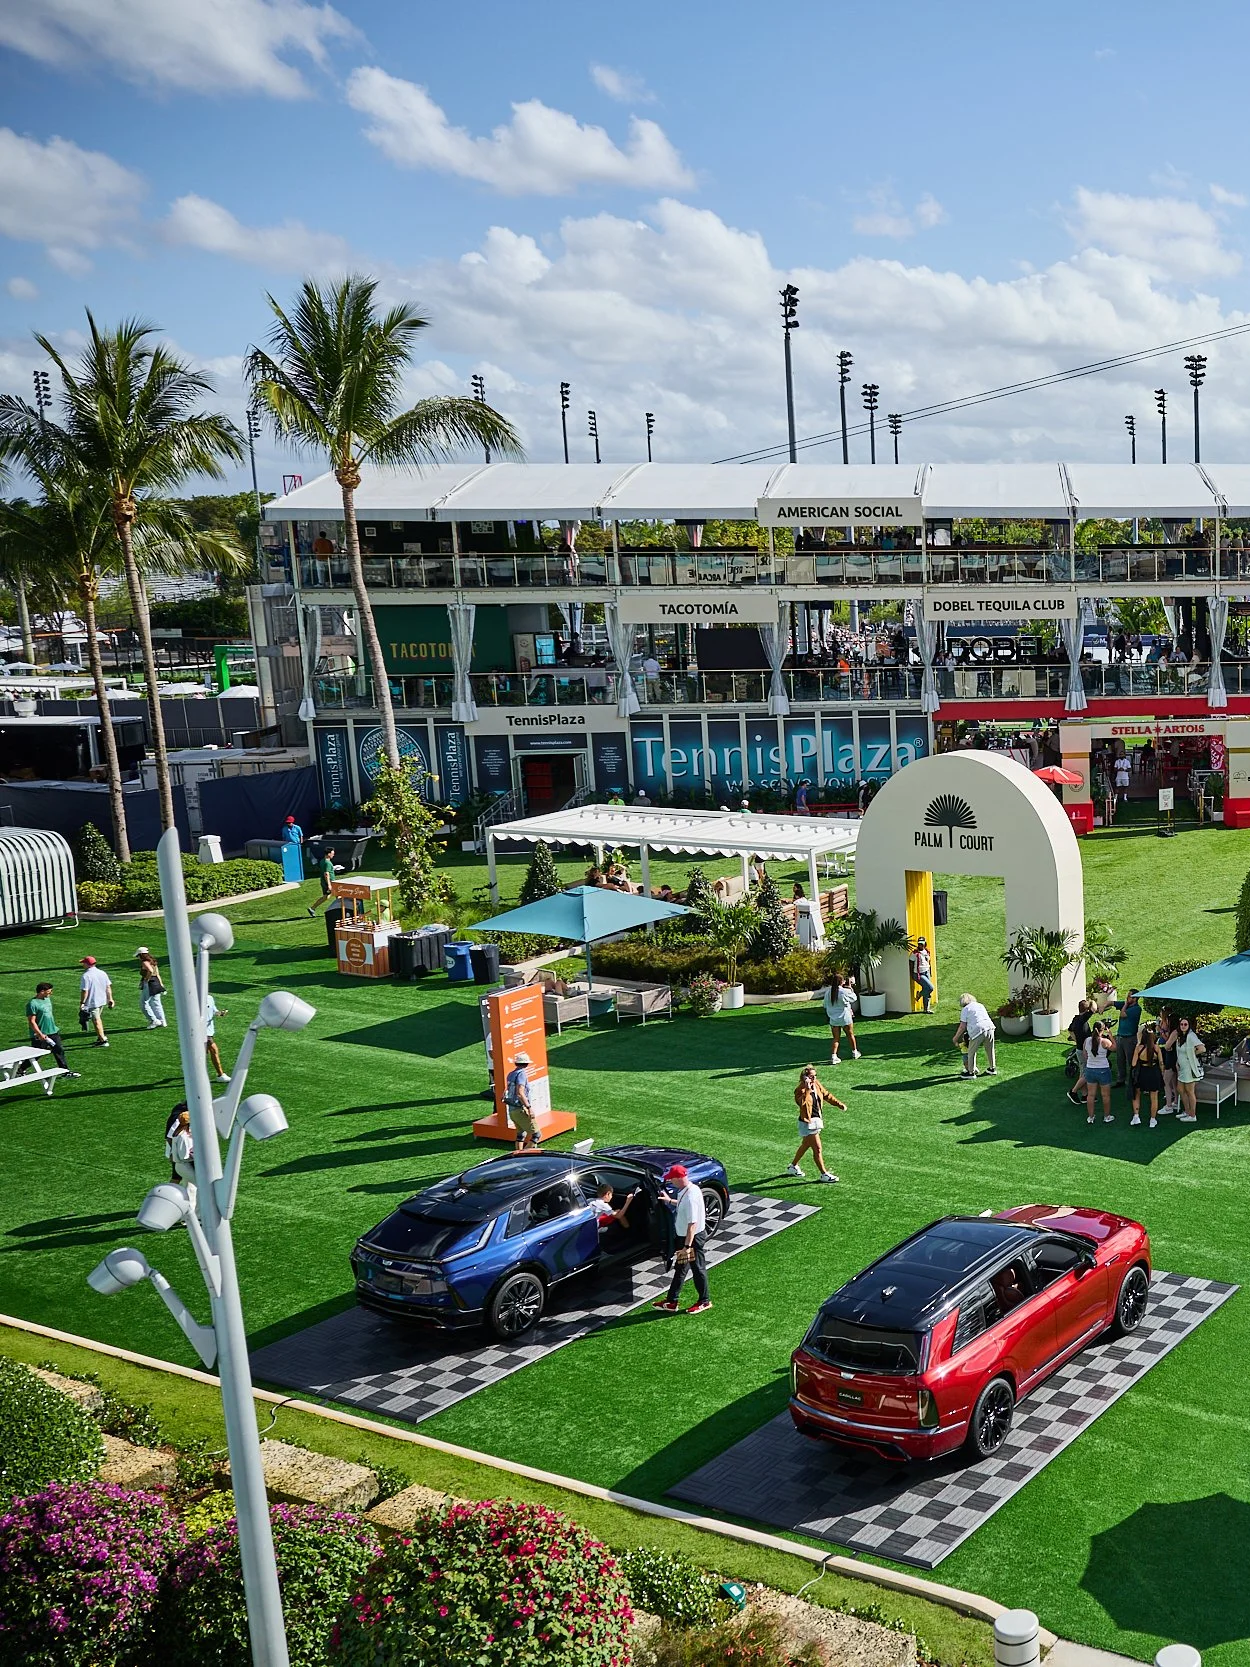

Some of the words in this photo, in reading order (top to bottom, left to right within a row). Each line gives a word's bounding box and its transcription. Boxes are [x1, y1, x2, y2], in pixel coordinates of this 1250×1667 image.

[776, 506, 849, 519] AMERICAN
[854, 505, 903, 518] SOCIAL
[658, 600, 739, 615] TACOTOMÍA
[933, 600, 975, 612] DOBEL
[976, 600, 1032, 612] TEQUILA
[1033, 599, 1065, 611] CLUB
[505, 713, 586, 726] TennisPlaza
[1111, 725, 1153, 735] STELLA
[1164, 724, 1205, 734] ARTOIS
[326, 733, 341, 799] TennisPlaza
[446, 732, 461, 798] TennisPlaza
[914, 831, 943, 848] PALM
[959, 834, 994, 851] COURT
[838, 1392, 862, 1401] CADILLAC
